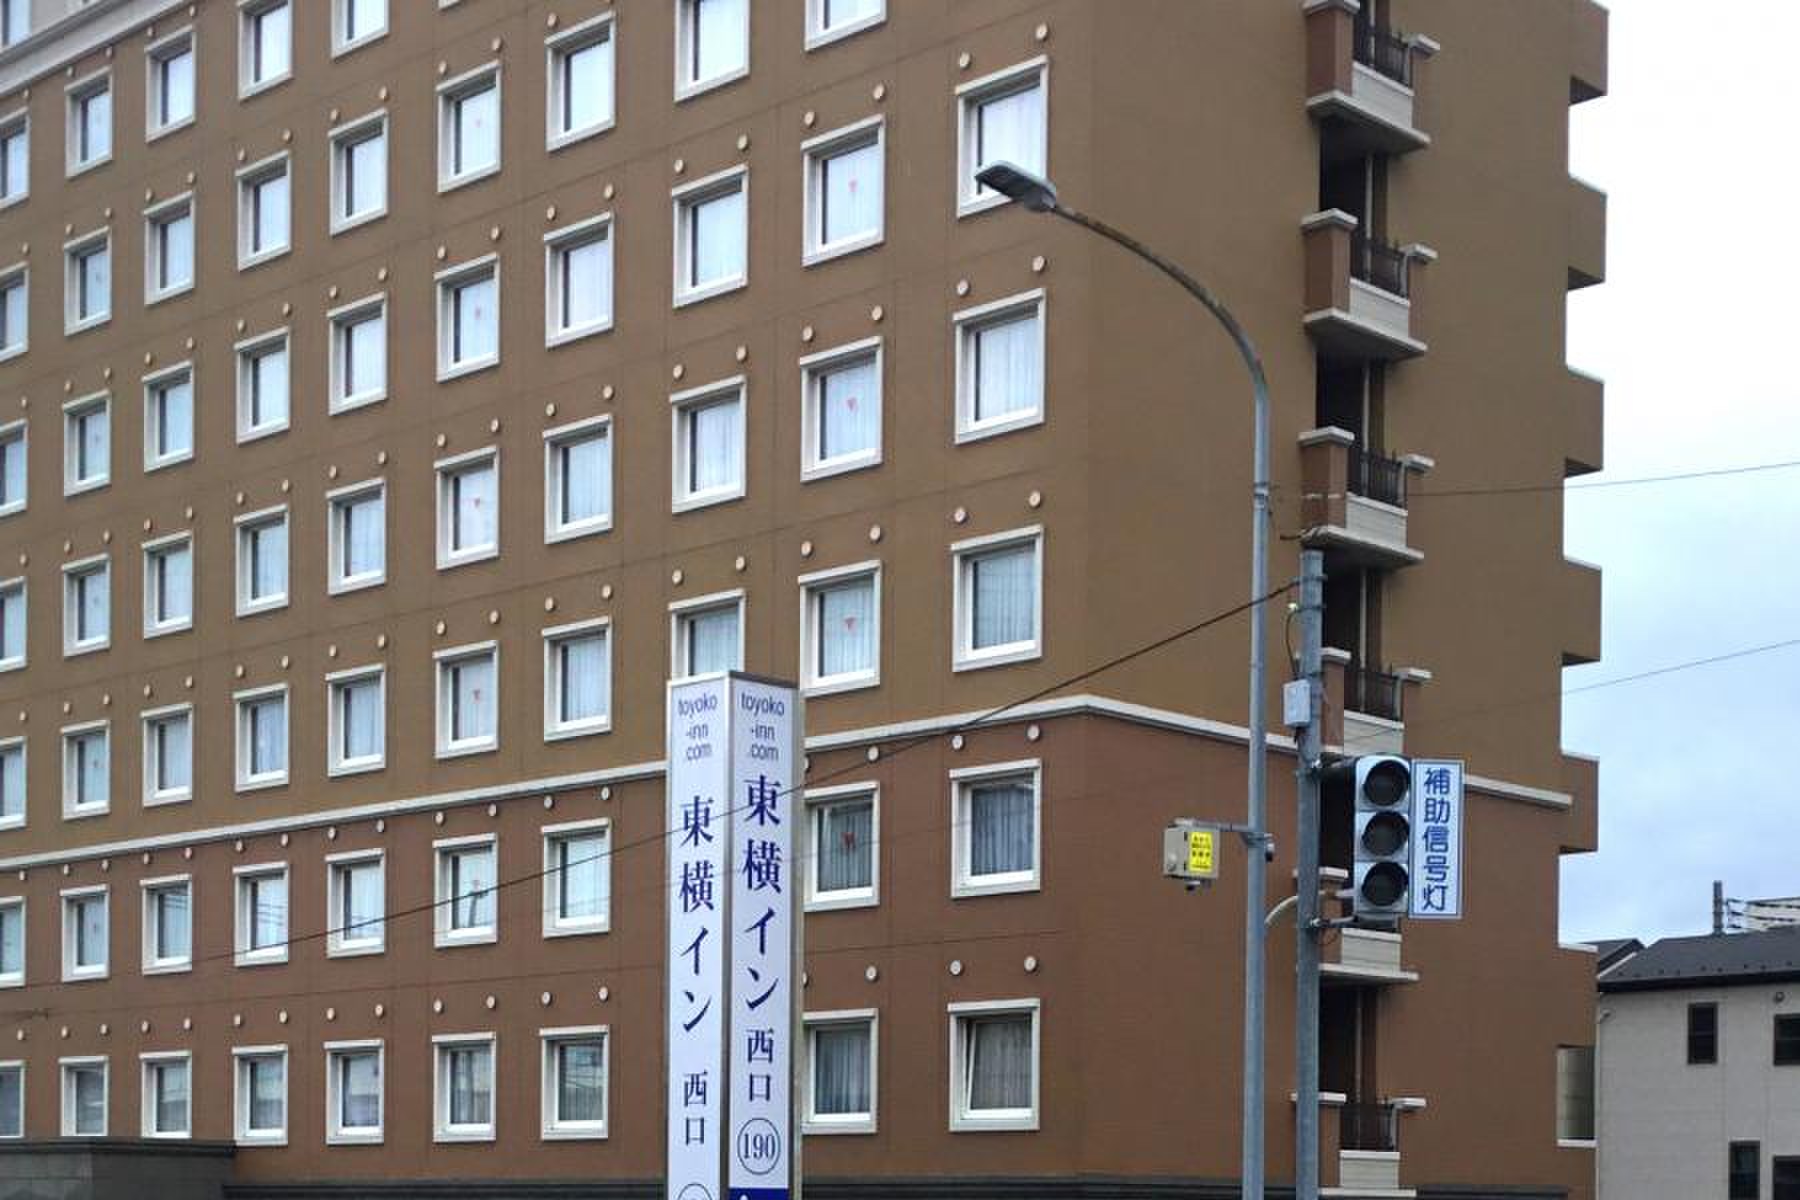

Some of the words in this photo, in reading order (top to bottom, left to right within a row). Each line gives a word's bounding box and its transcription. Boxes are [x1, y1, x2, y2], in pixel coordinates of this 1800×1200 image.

[678, 693, 718, 718] toyoko
[741, 692, 784, 716] toyoko
[1422, 768, 1452, 911] 補助信号灯
[679, 795, 715, 1032] 東横イン
[743, 774, 782, 1010] 東横イン
[746, 1027, 775, 1102] 西口
[683, 1070, 709, 1146] 西口
[743, 1132, 776, 1161] 190
